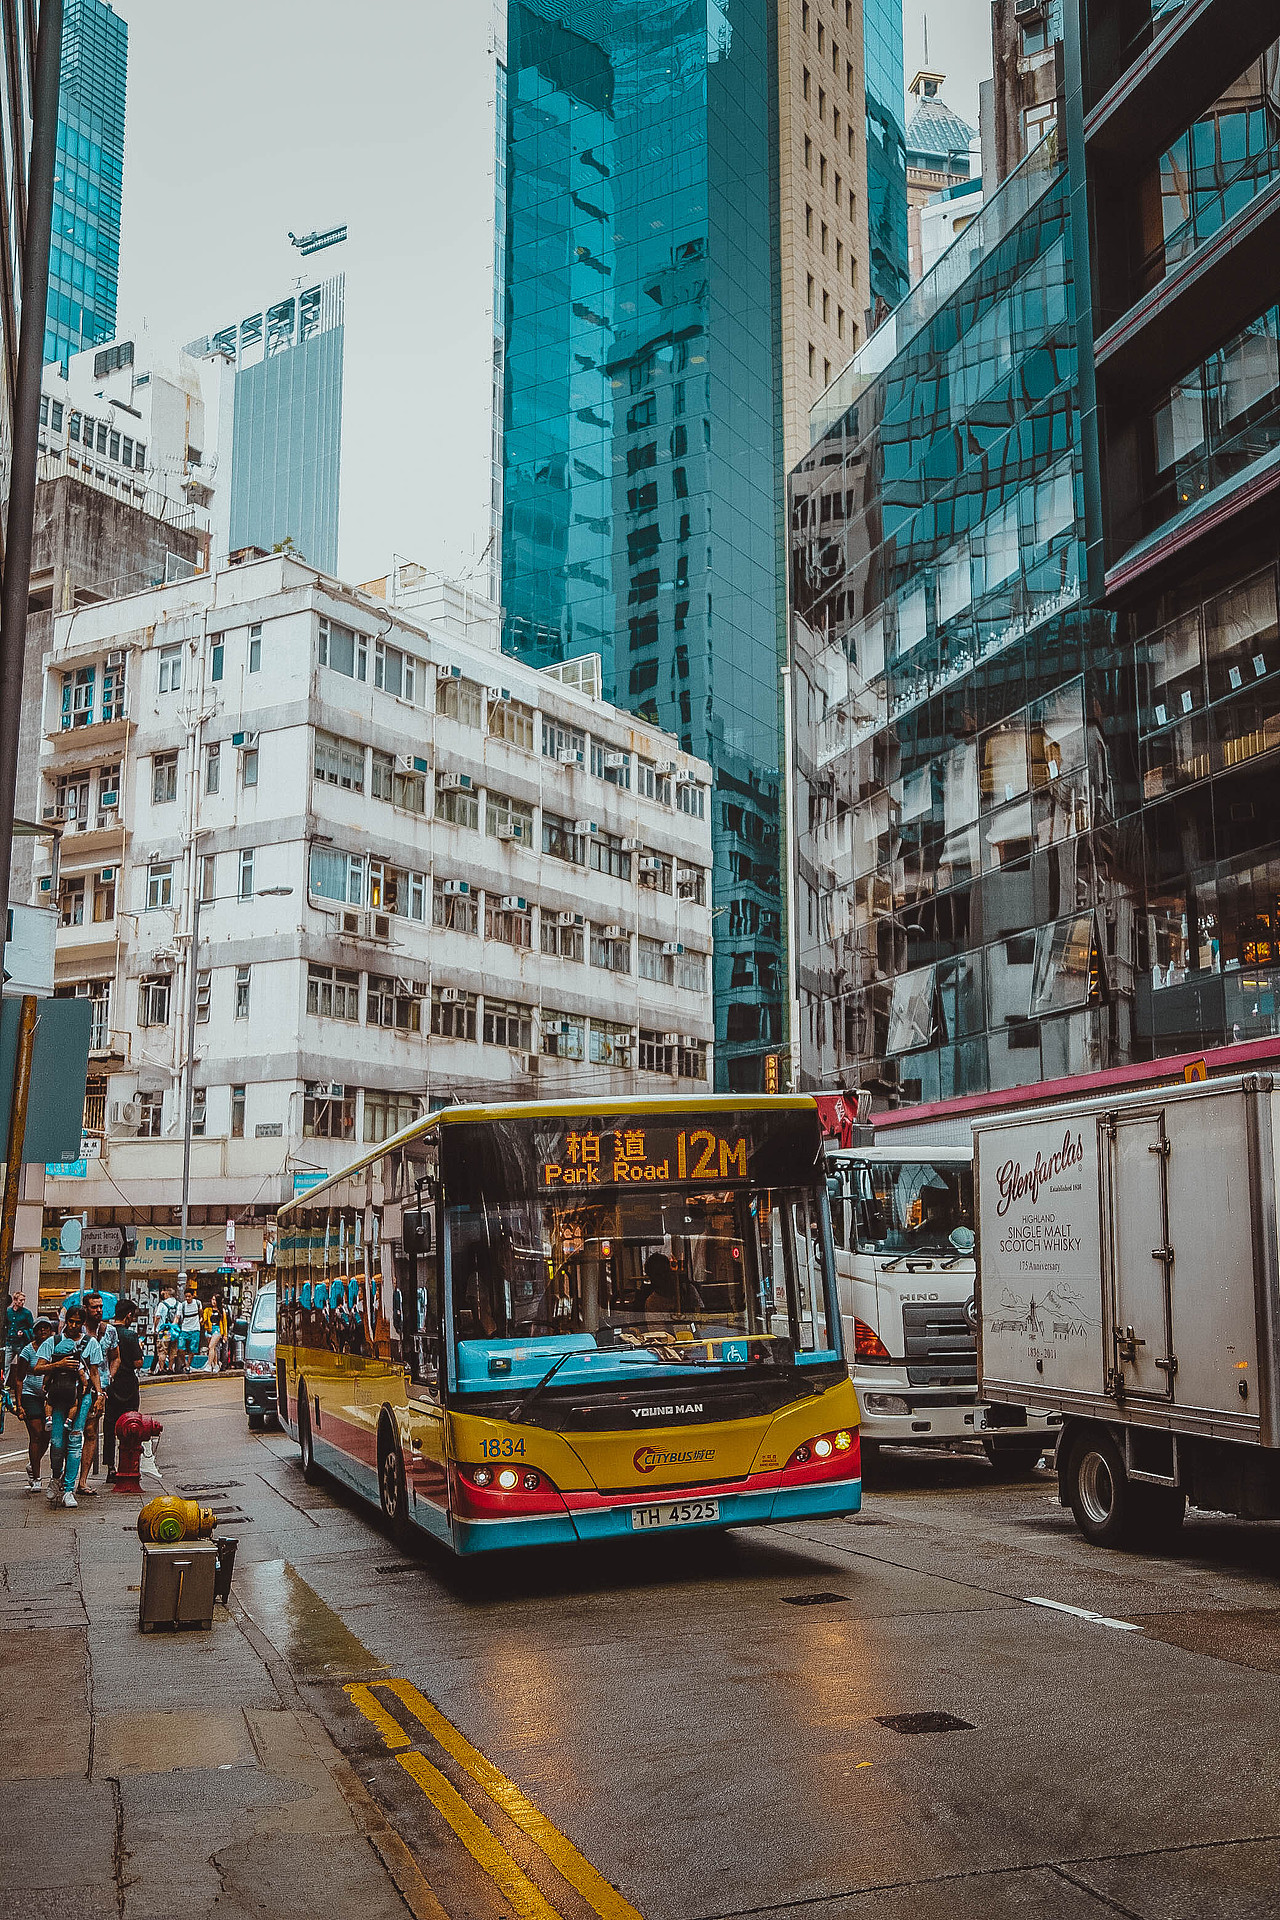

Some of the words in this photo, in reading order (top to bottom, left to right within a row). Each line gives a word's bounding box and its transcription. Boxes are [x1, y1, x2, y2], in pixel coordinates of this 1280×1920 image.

[566, 1129, 647, 1163] 柏道
[677, 1129, 747, 1179] 12M
[545, 1163, 600, 1185] Park
[613, 1159, 669, 1182] Road
[996, 1130, 1083, 1217] Glenfarclas
[1022, 1213, 1056, 1224] HIGHLAND
[1008, 1226, 1042, 1239] SINGLE
[1044, 1224, 1072, 1237] MALT
[145, 1237, 204, 1251] Products
[1000, 1240, 1041, 1253] SCOTCH
[1043, 1238, 1082, 1251] WHISKY
[1028, 1261, 1061, 1273] Anniversary
[900, 1292, 939, 1301] HINO
[631, 1406, 673, 1417] YOUNG
[675, 1403, 703, 1414] MAN
[479, 1438, 527, 1458] 1834
[644, 1452, 692, 1465] CITYBUS
[637, 1509, 661, 1526] TH
[669, 1502, 715, 1521] 4525
